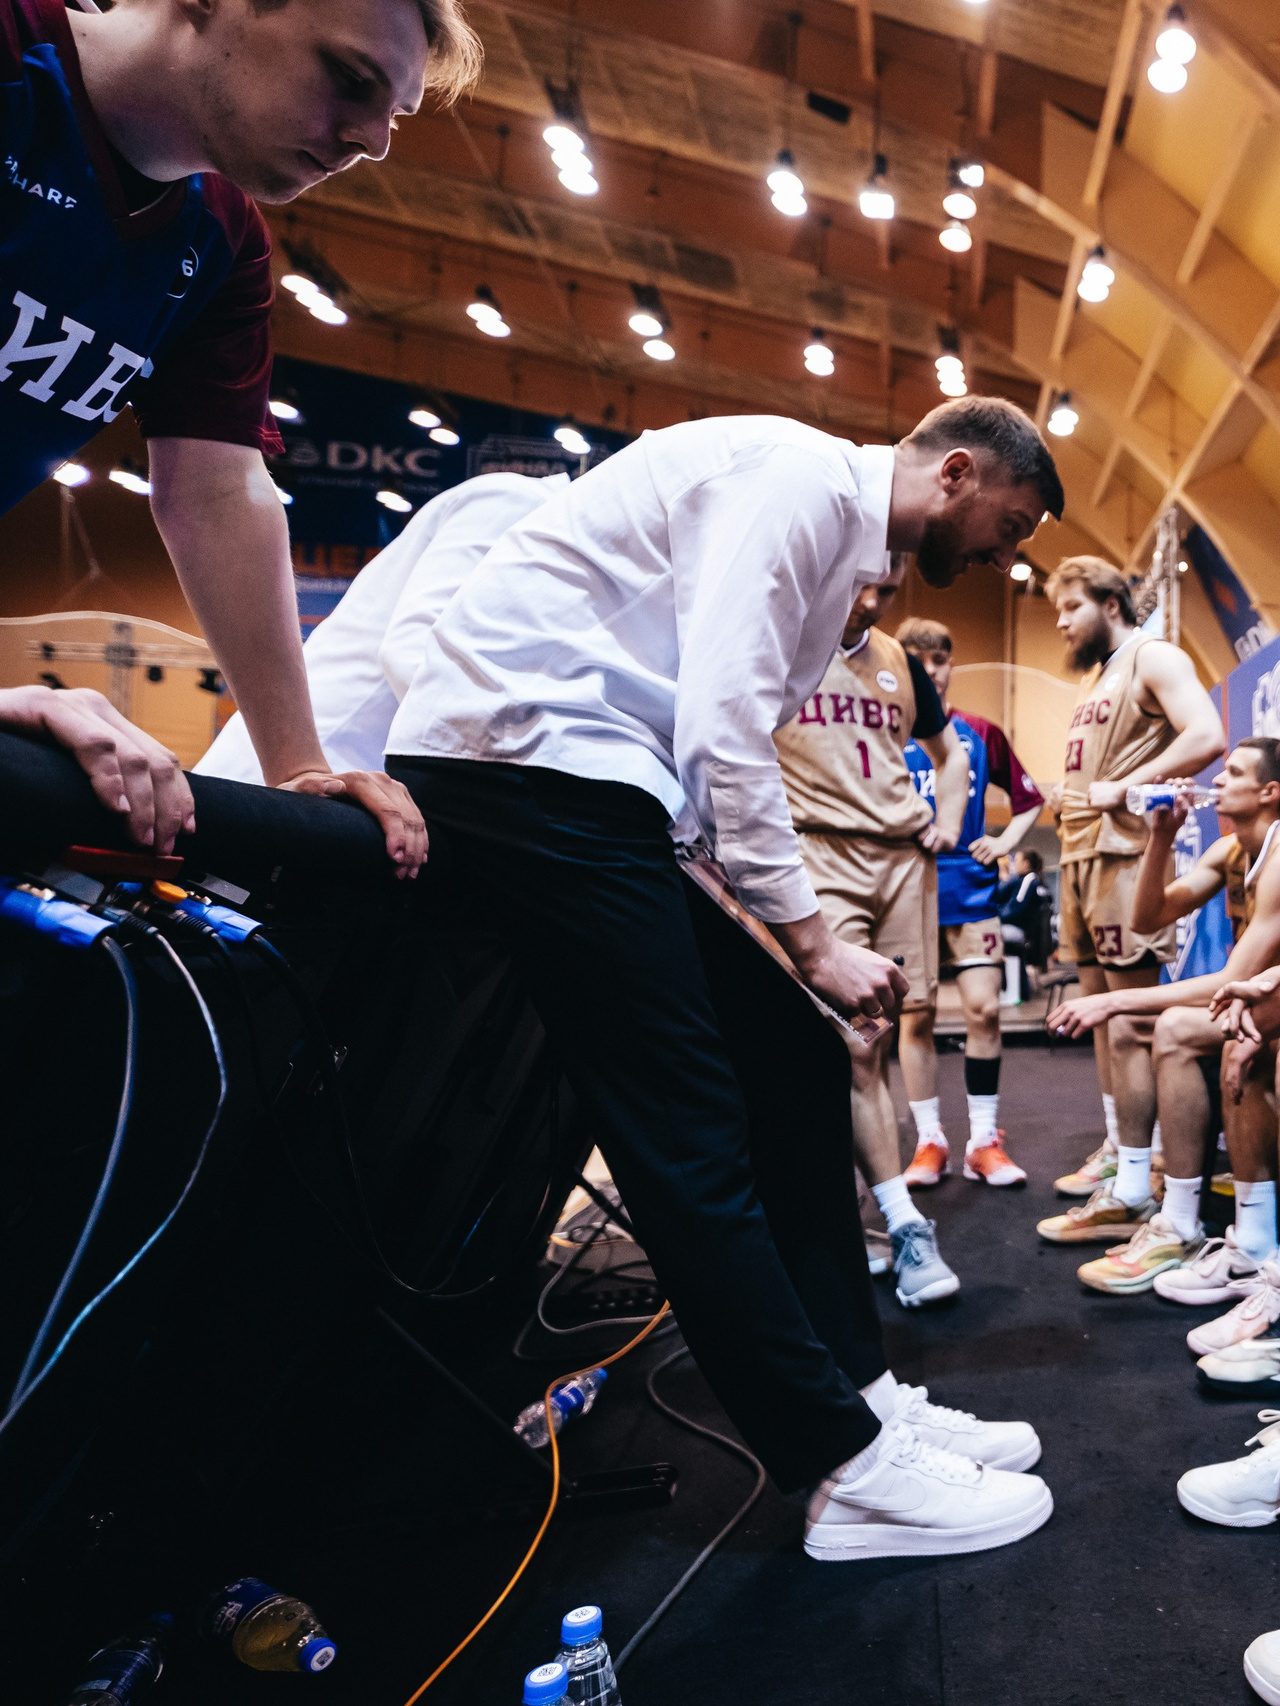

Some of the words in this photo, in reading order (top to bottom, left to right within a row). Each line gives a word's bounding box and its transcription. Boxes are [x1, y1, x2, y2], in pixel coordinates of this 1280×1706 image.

[798, 693, 902, 733] ЦИВС
[856, 740, 871, 778] 1
[1094, 925, 1122, 957] 23
